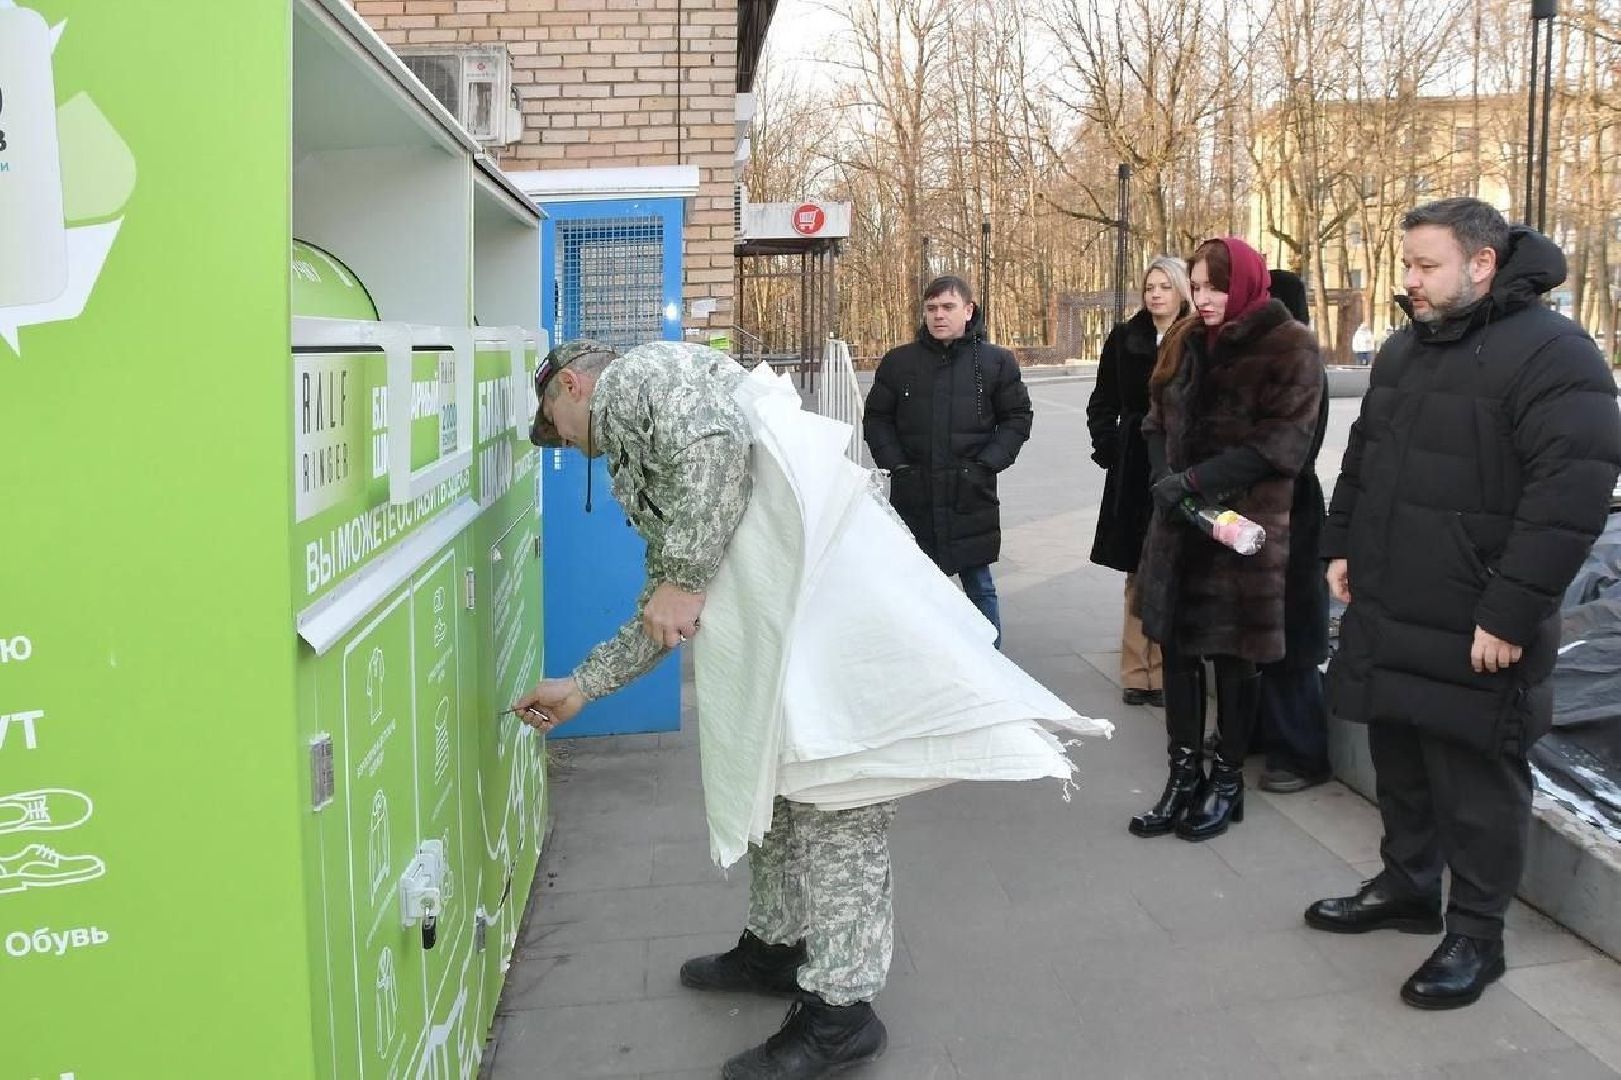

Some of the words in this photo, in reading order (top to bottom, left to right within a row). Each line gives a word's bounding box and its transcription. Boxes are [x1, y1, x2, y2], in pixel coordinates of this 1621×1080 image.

[302, 370, 347, 435] RALF
[302, 443, 348, 493] RINGER
[306, 531, 336, 596] ВЫ
[338, 501, 397, 574] МОЖЕТЕ
[5, 926, 110, 957] Обувь
